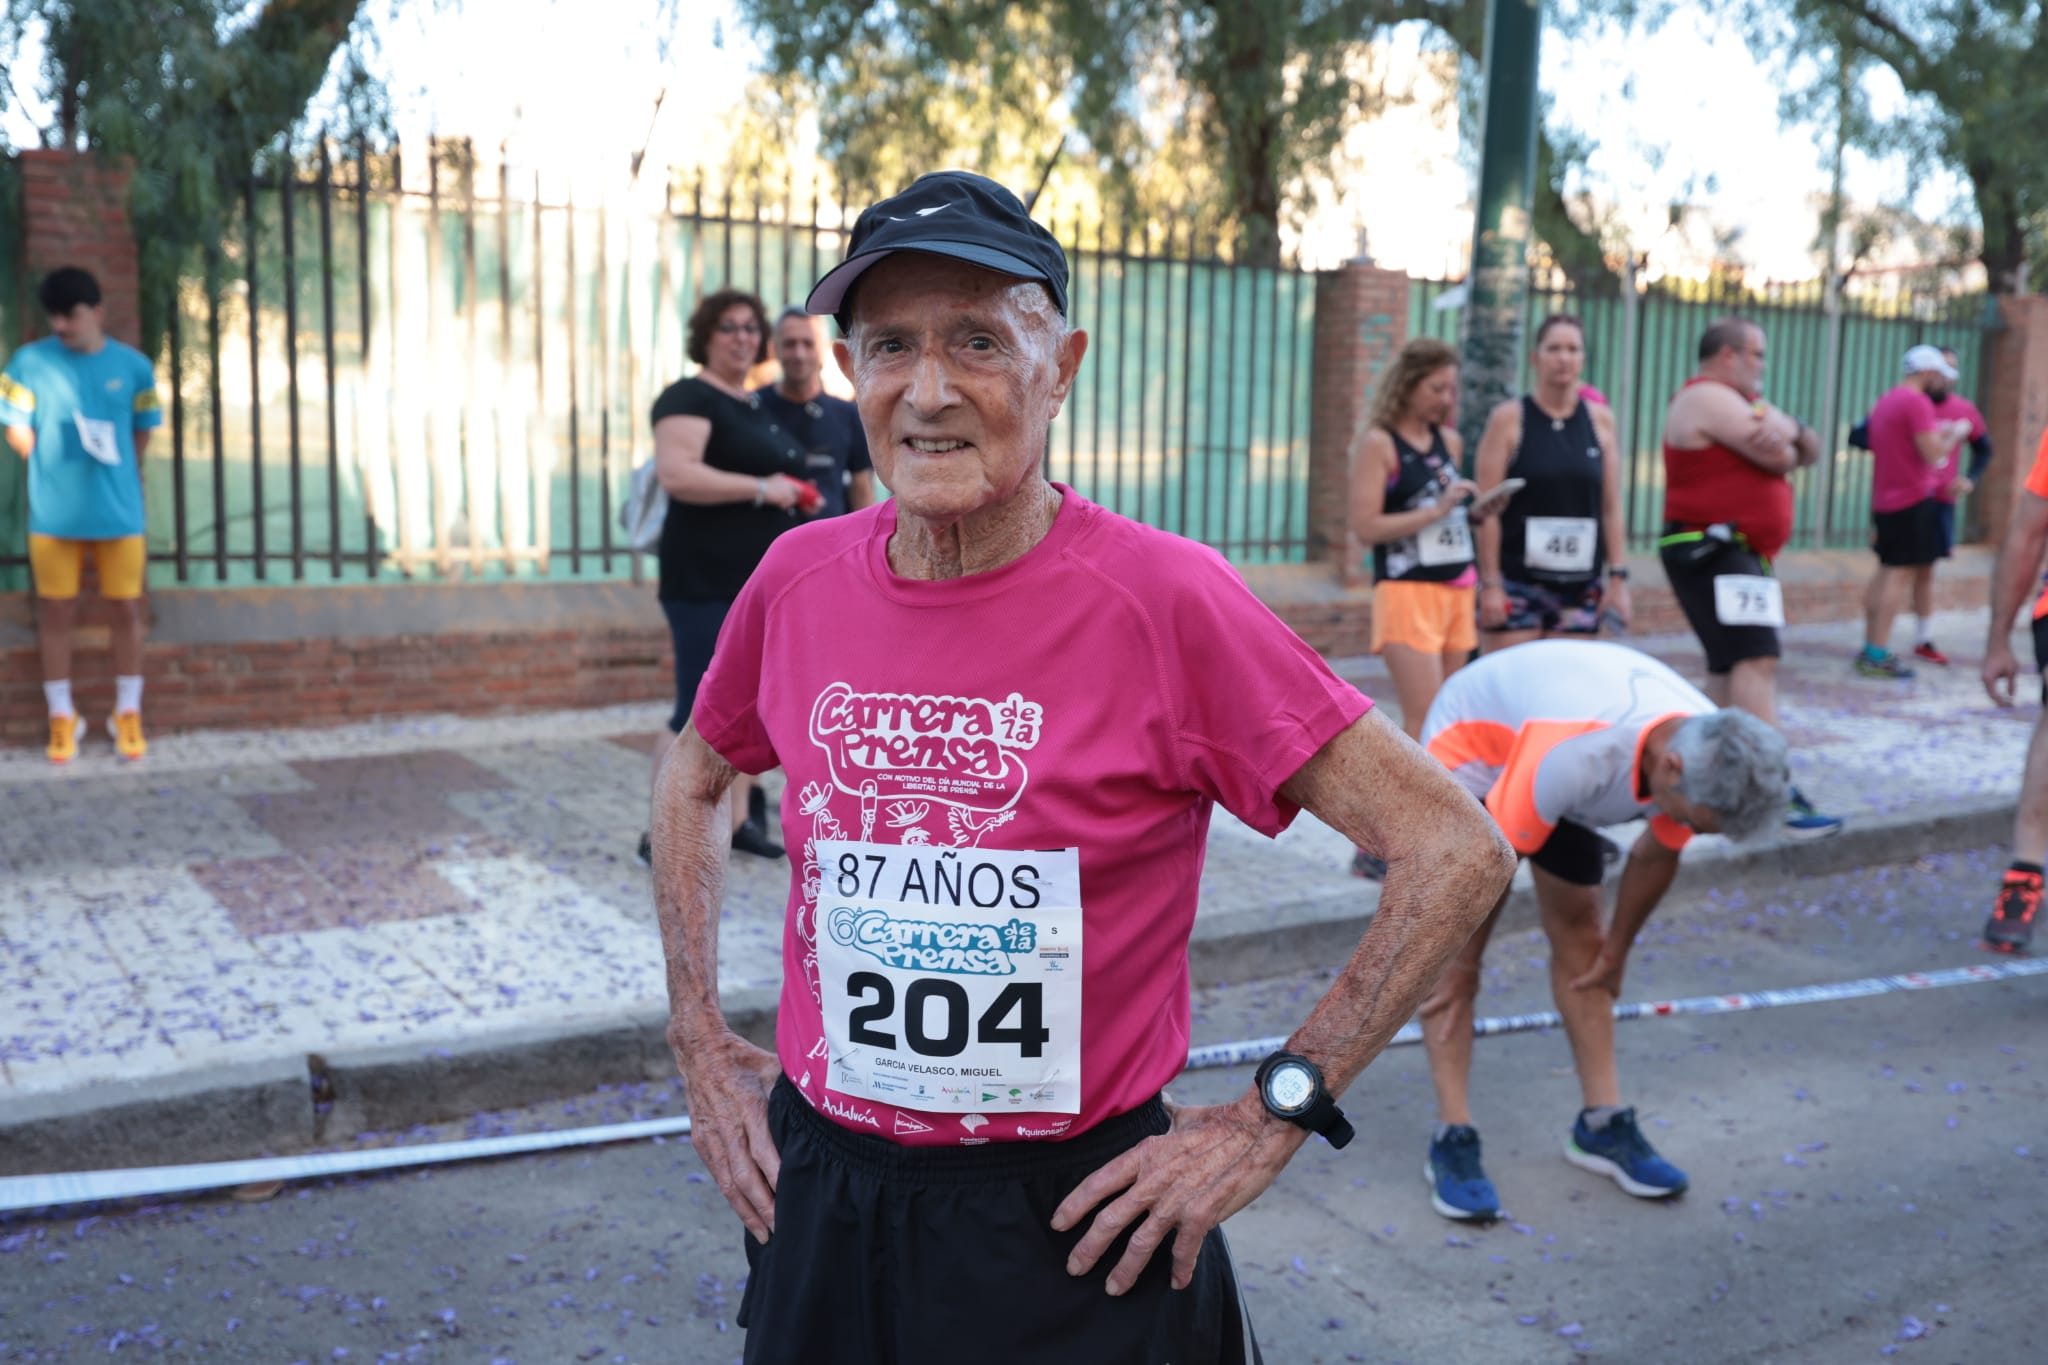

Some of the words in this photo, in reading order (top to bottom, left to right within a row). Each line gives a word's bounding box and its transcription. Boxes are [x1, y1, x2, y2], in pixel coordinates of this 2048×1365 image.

[819, 694, 994, 736] Carrera
[1000, 701, 1036, 721] de
[1003, 719, 1034, 744] la
[845, 731, 1002, 776] Prensa
[877, 773, 893, 781] CON
[894, 774, 919, 783] MOTIVO
[922, 776, 936, 784] DEL
[952, 779, 981, 788] MUNDIAL
[983, 781, 994, 789] DE
[996, 782, 1005, 790] LA
[902, 782, 936, 792] LIBERTAD
[938, 785, 948, 793] DE
[949, 786, 979, 795] PRENSA
[837, 852, 887, 899] 87
[899, 851, 1041, 909] AÑOS
[858, 917, 1002, 950] Carrera
[1004, 922, 1031, 937] de
[1004, 935, 1033, 950] la
[1051, 926, 1058, 935] S
[883, 943, 1012, 975] Prensa
[846, 971, 1050, 1058] 204
[875, 1057, 906, 1070] GARCIA
[908, 1063, 958, 1077] VELASCO,
[960, 1067, 1003, 1077] MIGUEL
[822, 1095, 880, 1128] Andalucía
